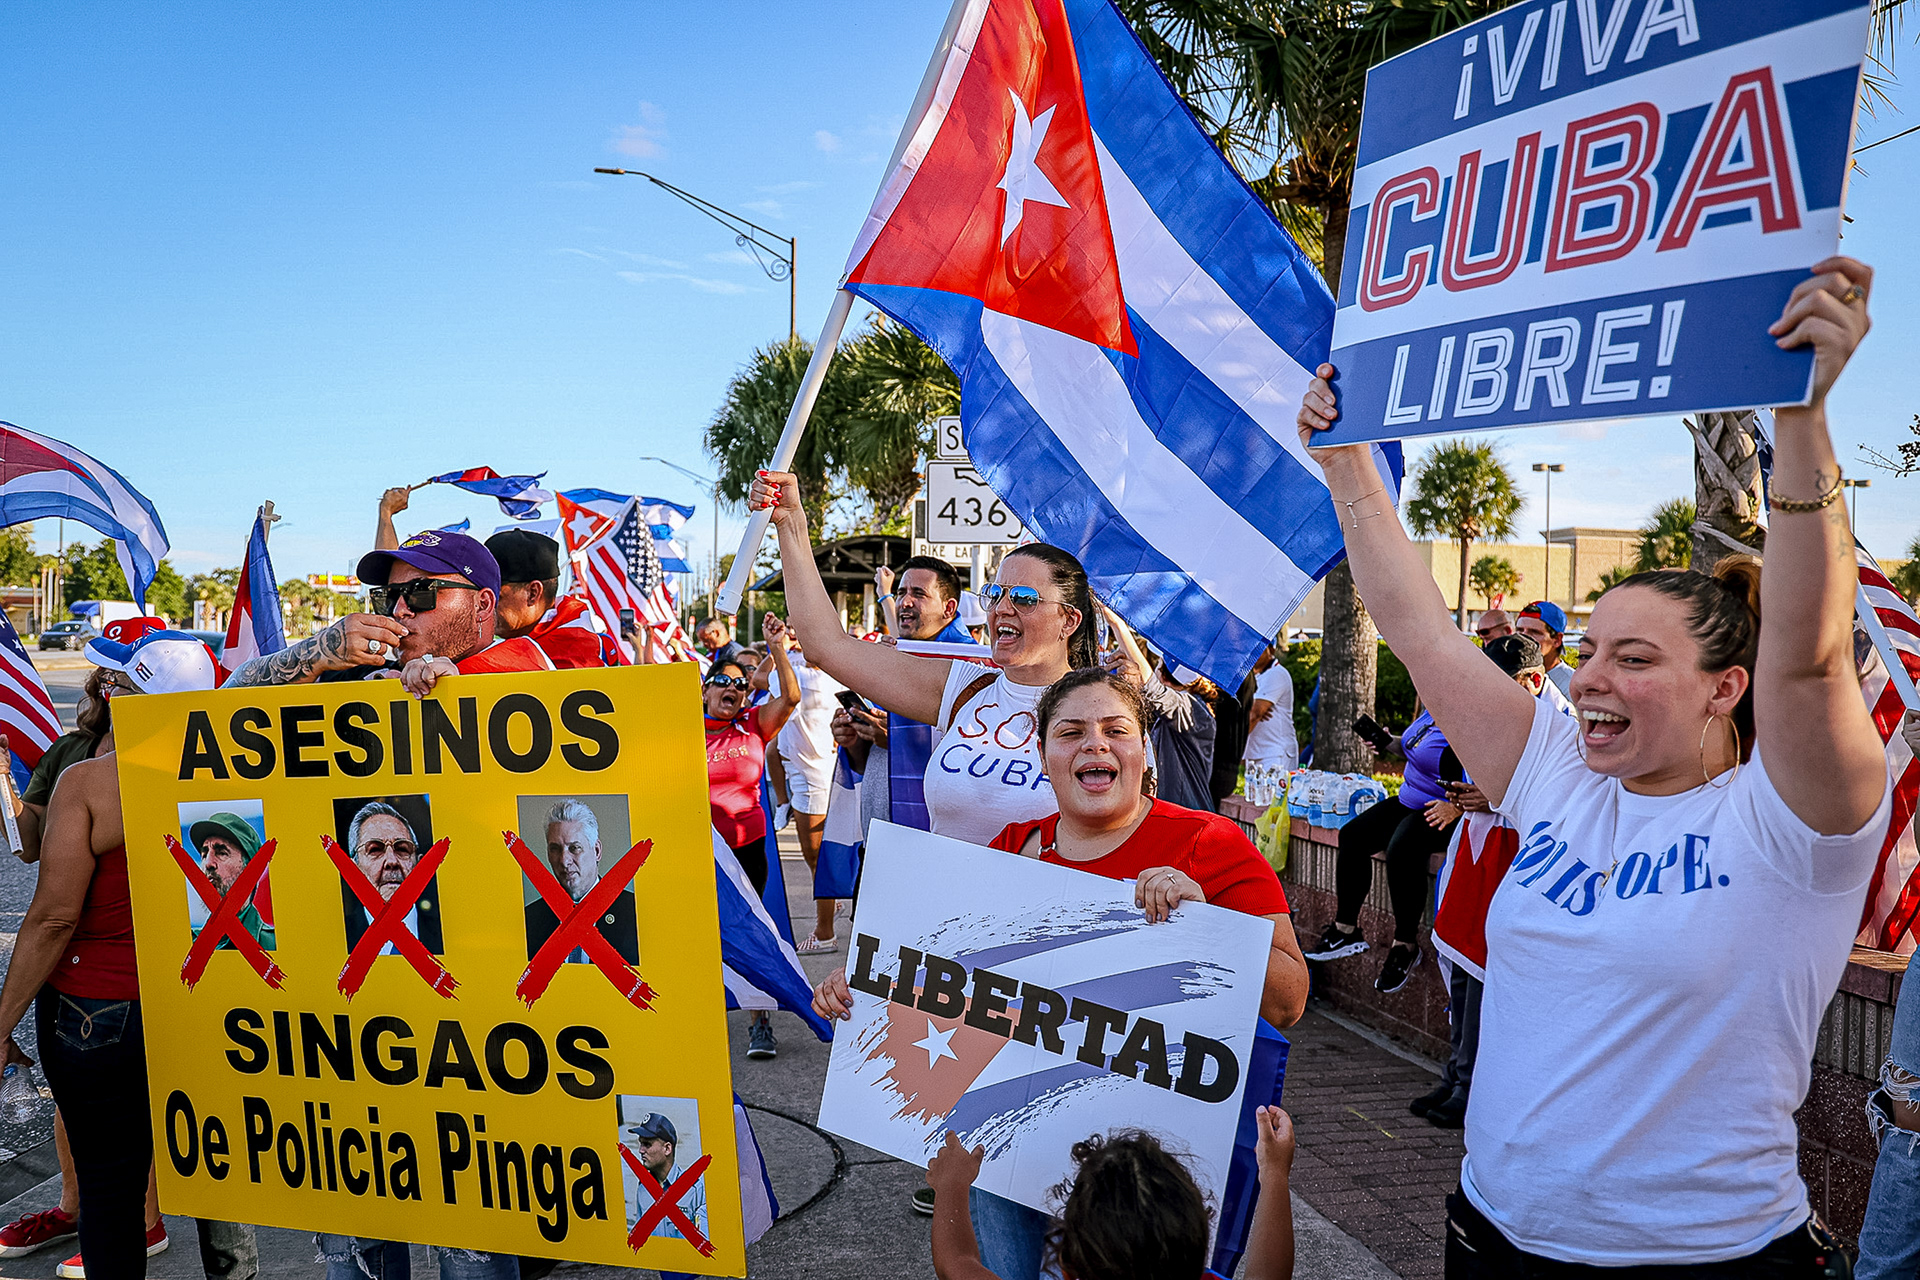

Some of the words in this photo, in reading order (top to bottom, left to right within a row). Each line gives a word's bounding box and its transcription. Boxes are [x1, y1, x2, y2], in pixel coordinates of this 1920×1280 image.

[1453, 0, 1700, 120] ¡VIVA
[1360, 66, 1801, 312] CUBA
[1383, 300, 1686, 426] LIBRE!
[920, 545, 945, 558] BIKE
[937, 497, 1007, 526] 436
[177, 690, 620, 780] ASESINOS
[1541, 858, 1606, 916] IS
[1611, 833, 1730, 900] OPE.
[224, 1007, 616, 1100] SINGAOS
[848, 933, 1240, 1103] LIBERTAD
[242, 1096, 422, 1202] Policia
[435, 1111, 609, 1243] Pinga
